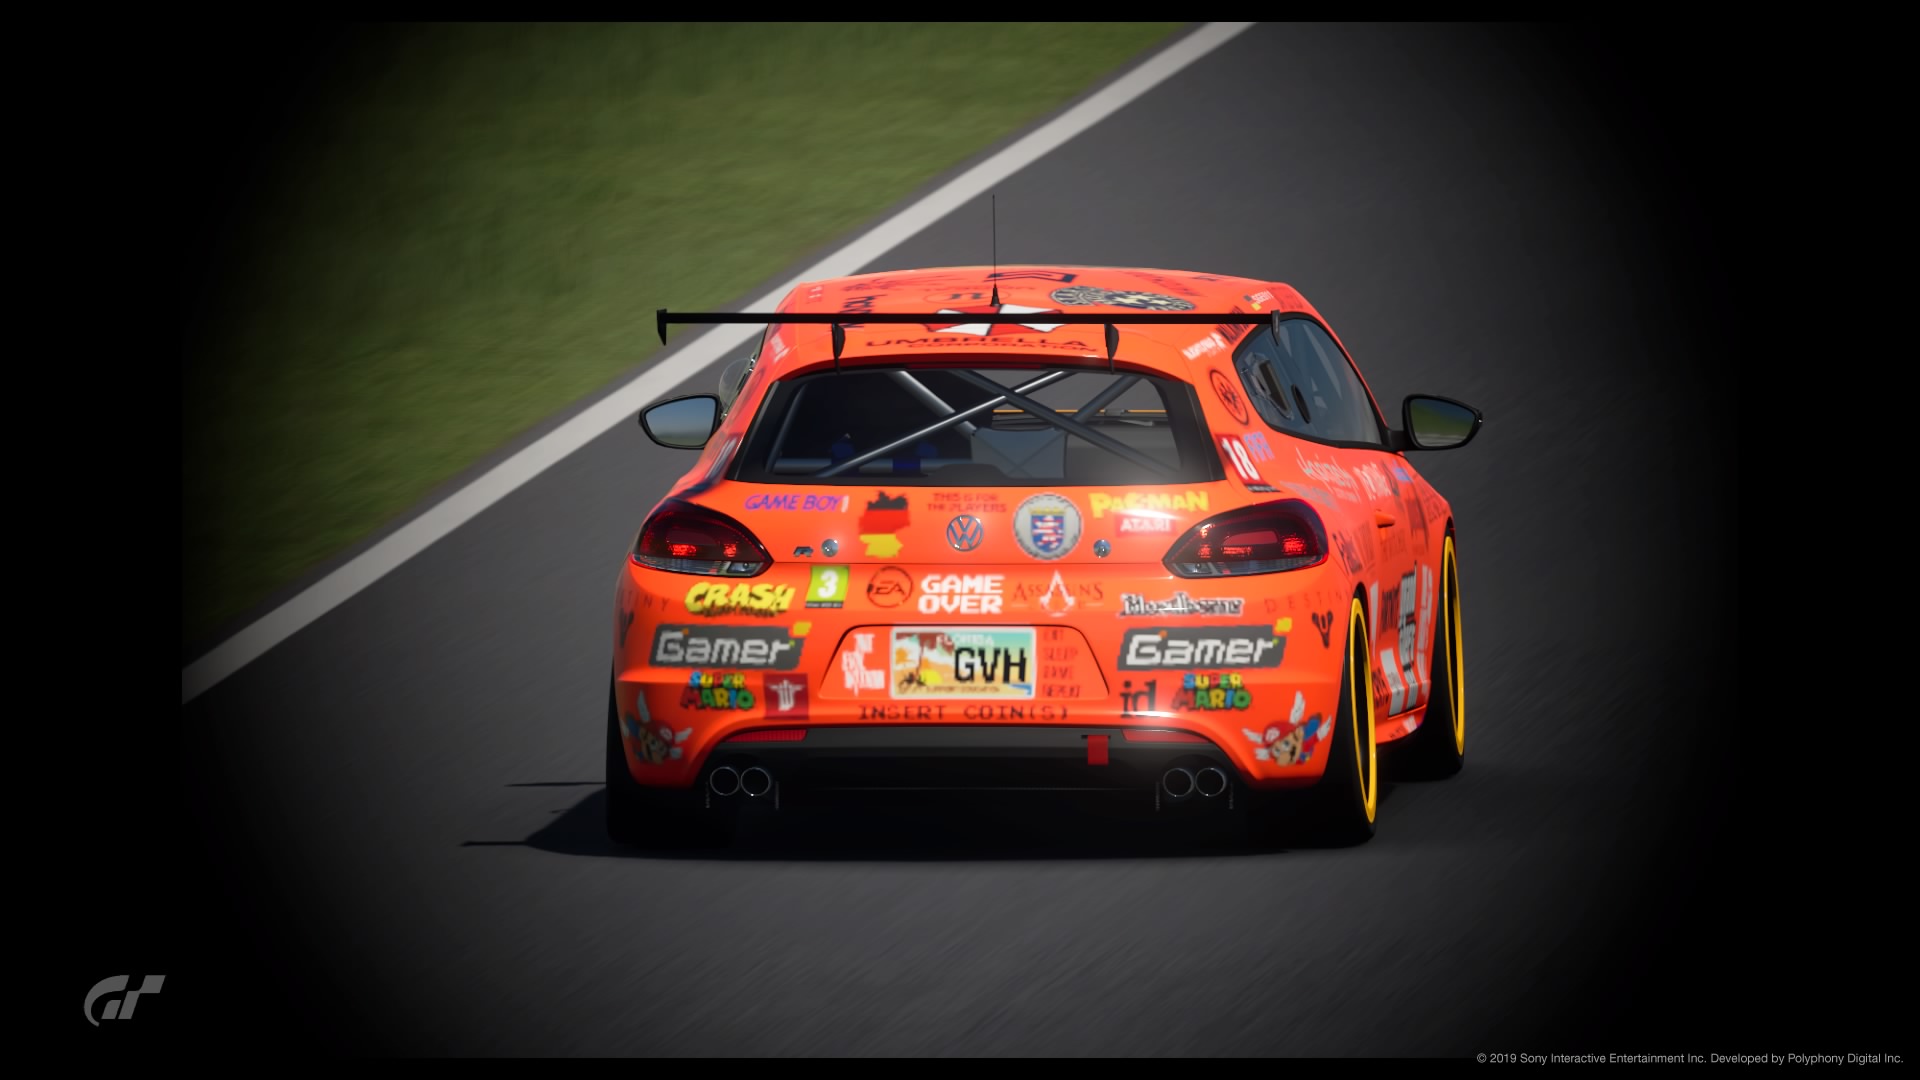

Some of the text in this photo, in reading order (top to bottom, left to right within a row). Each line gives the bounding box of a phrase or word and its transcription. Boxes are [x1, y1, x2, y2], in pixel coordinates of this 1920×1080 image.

[1222, 437, 1261, 481] 18
[744, 494, 840, 512] GAME BOY
[1119, 518, 1170, 532] ATARI
[817, 570, 840, 599] 3
[920, 574, 1005, 594] GAME
[684, 581, 796, 613] CRASH
[917, 594, 1003, 615] OVER
[655, 630, 792, 664] Gamer
[1126, 634, 1274, 666] Gamer
[954, 648, 1027, 683] GVH
[690, 672, 745, 690] SUPER
[1183, 673, 1242, 690] SUPER
[682, 687, 754, 710] MARIO
[1172, 688, 1252, 710] MARIO
[858, 705, 1069, 721] INSERT COIN(S)
